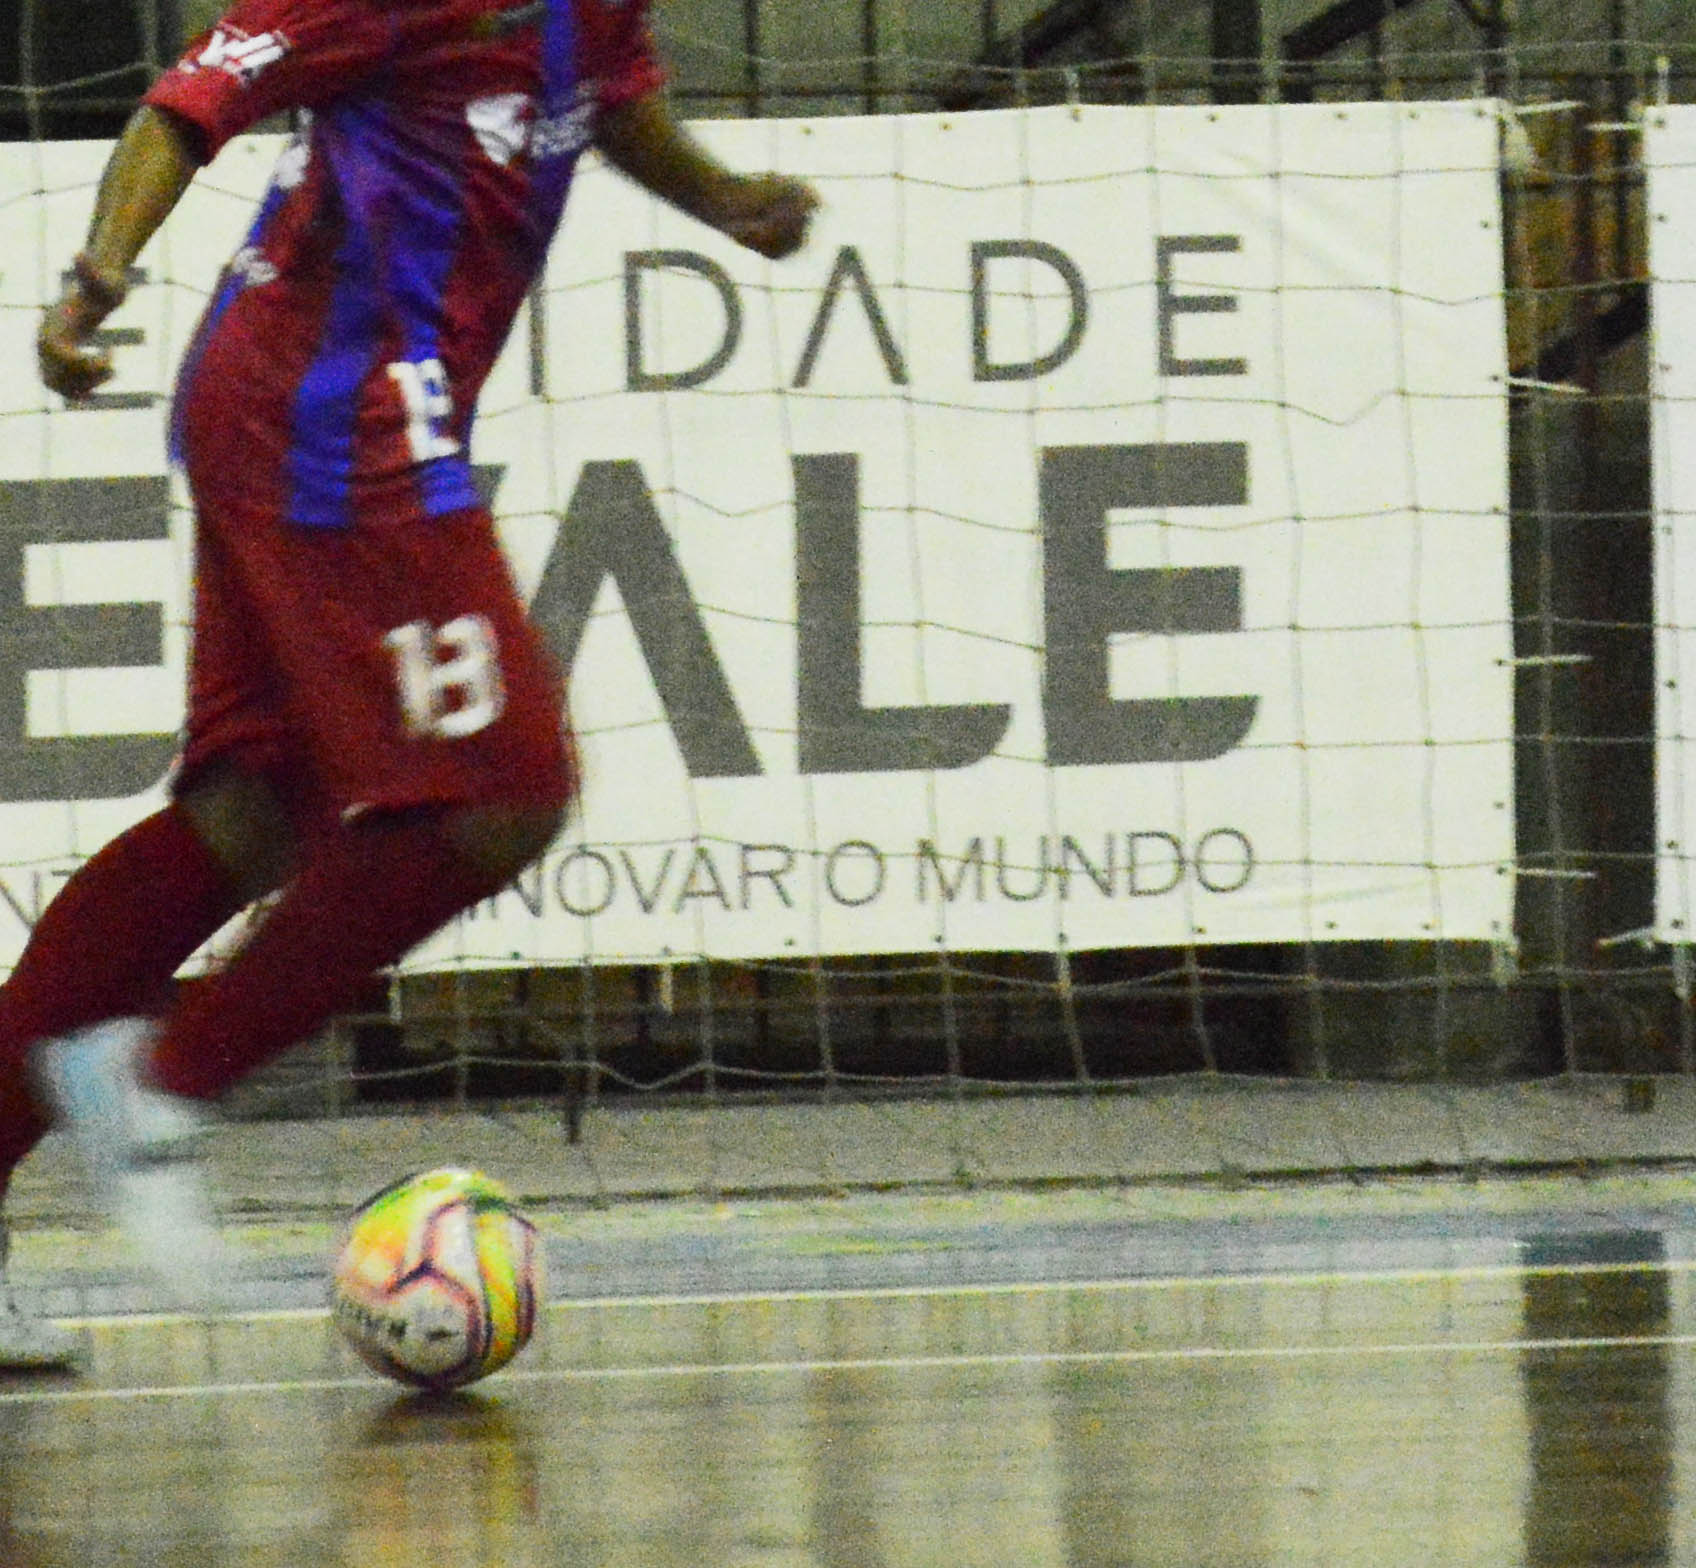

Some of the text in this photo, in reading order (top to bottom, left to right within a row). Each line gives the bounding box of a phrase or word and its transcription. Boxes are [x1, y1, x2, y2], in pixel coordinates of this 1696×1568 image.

[383, 614, 508, 738] 13
[826, 840, 884, 907] O
[915, 826, 1255, 904] MUNDO
